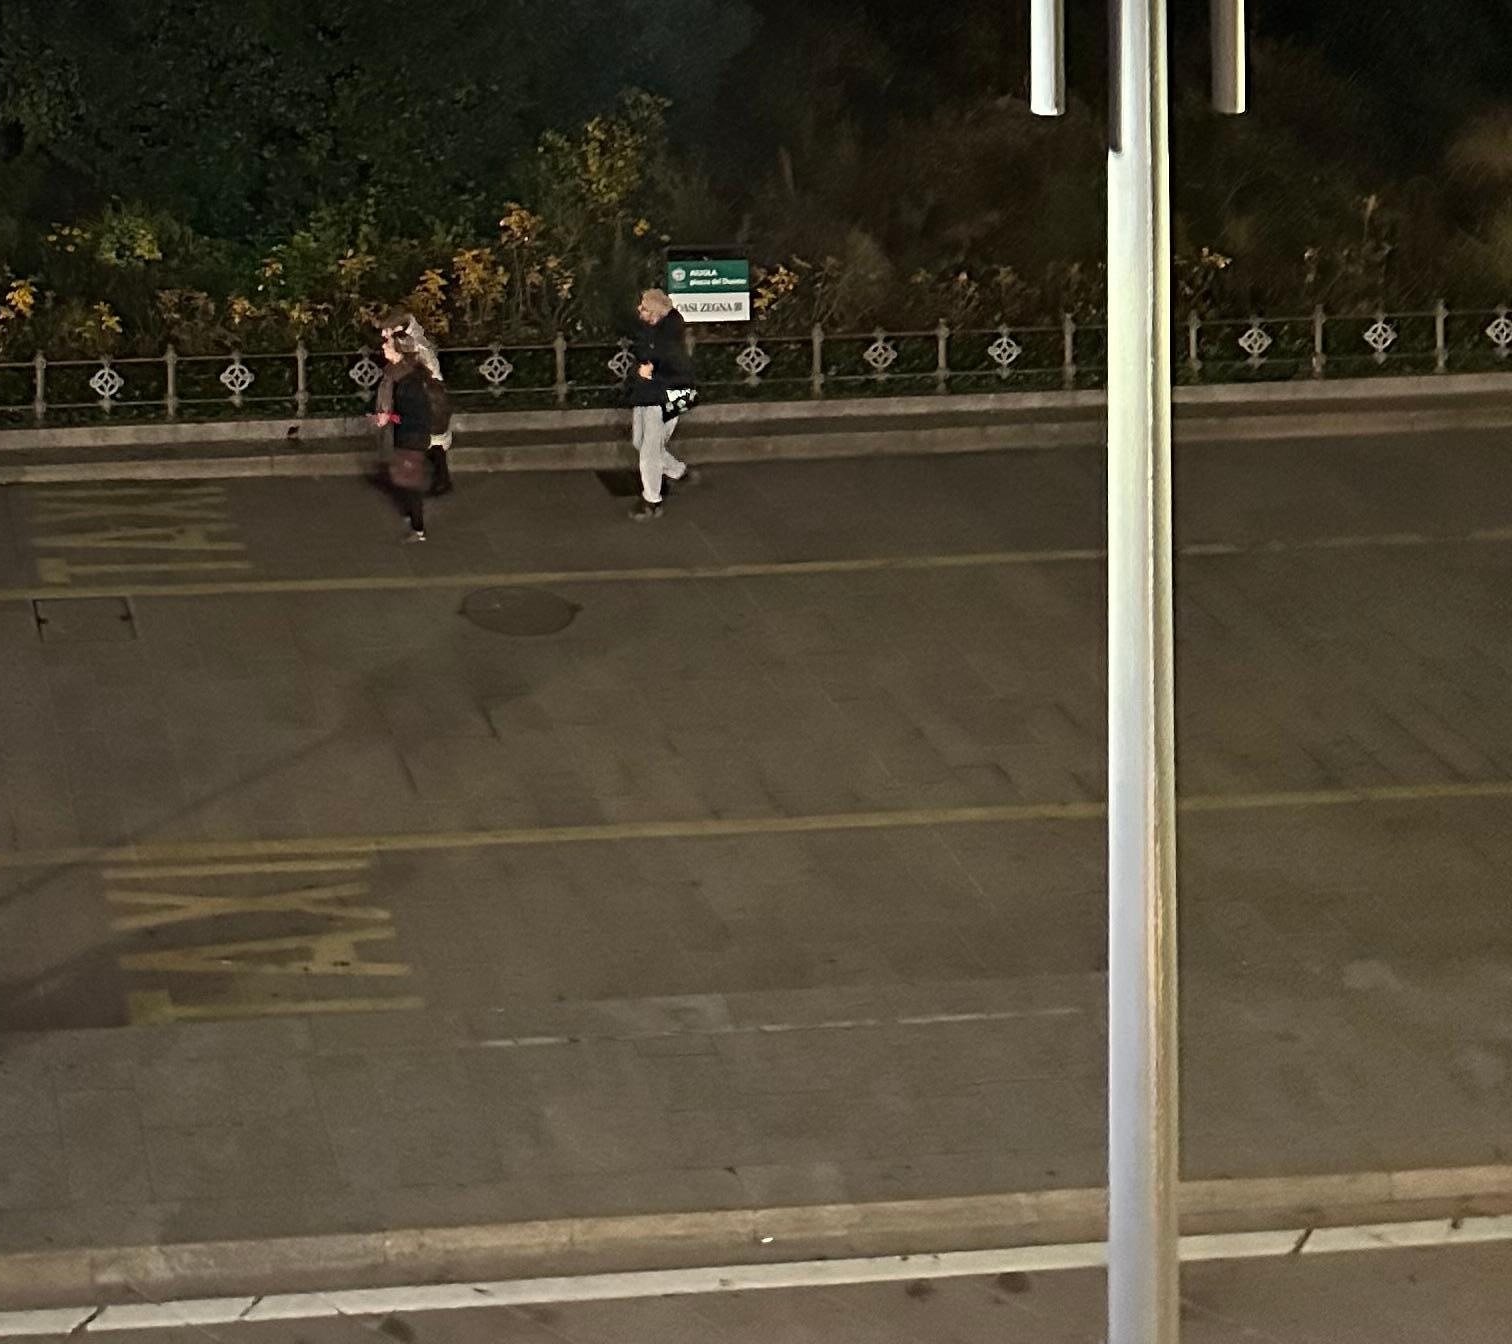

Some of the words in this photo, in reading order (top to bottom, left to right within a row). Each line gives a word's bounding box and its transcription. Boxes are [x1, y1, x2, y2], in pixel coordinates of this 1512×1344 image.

[700, 302, 733, 313] ZEGNA
[32, 486, 254, 585] TAXI
[102, 859, 426, 1027] TAXI
